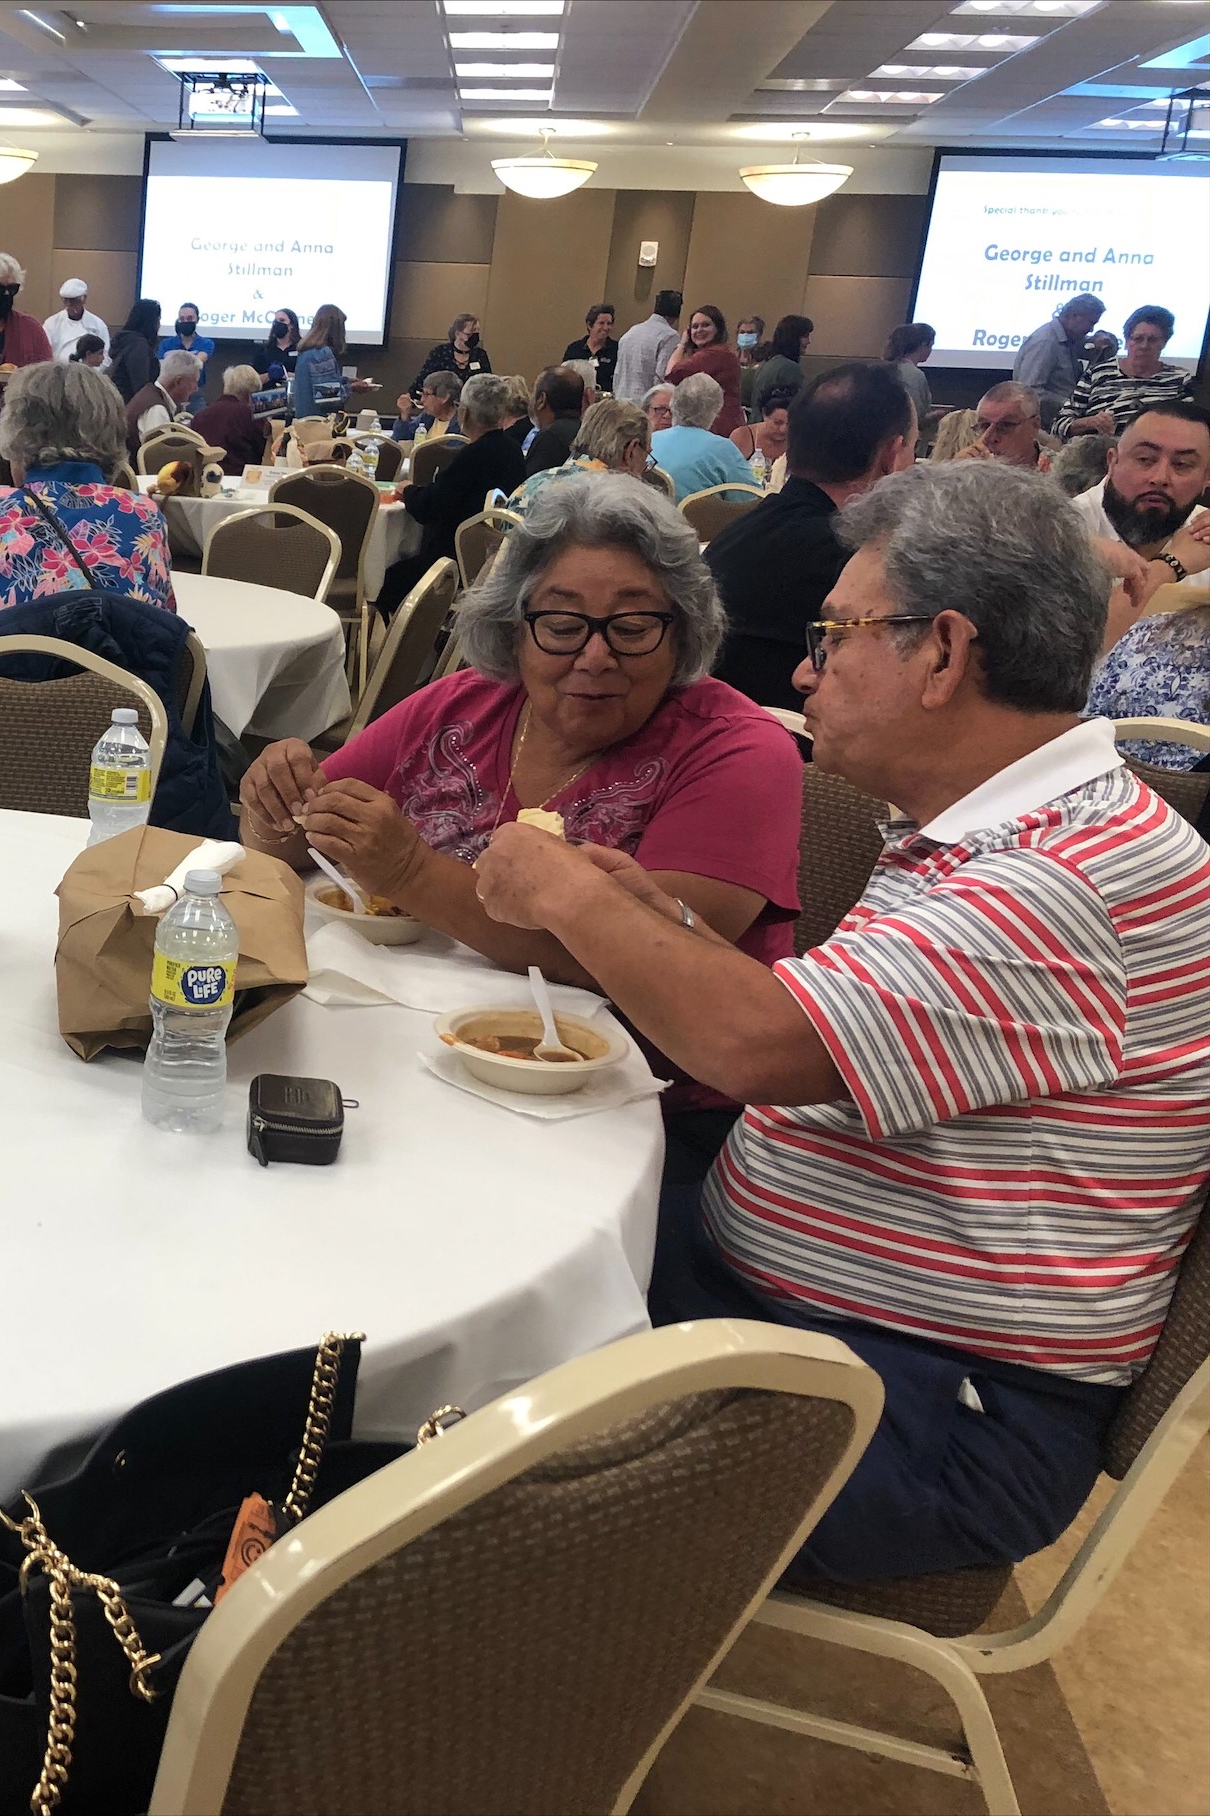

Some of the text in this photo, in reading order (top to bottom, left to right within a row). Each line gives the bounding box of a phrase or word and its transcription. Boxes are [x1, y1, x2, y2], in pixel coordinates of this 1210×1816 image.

[983, 205, 1016, 215] Special
[191, 238, 334, 254] George and Anna
[984, 244, 1154, 265] George and Anna
[228, 262, 293, 276] Stillman
[1025, 273, 1103, 291] Stillman
[253, 289, 264, 299] &
[198, 311, 236, 325] oger
